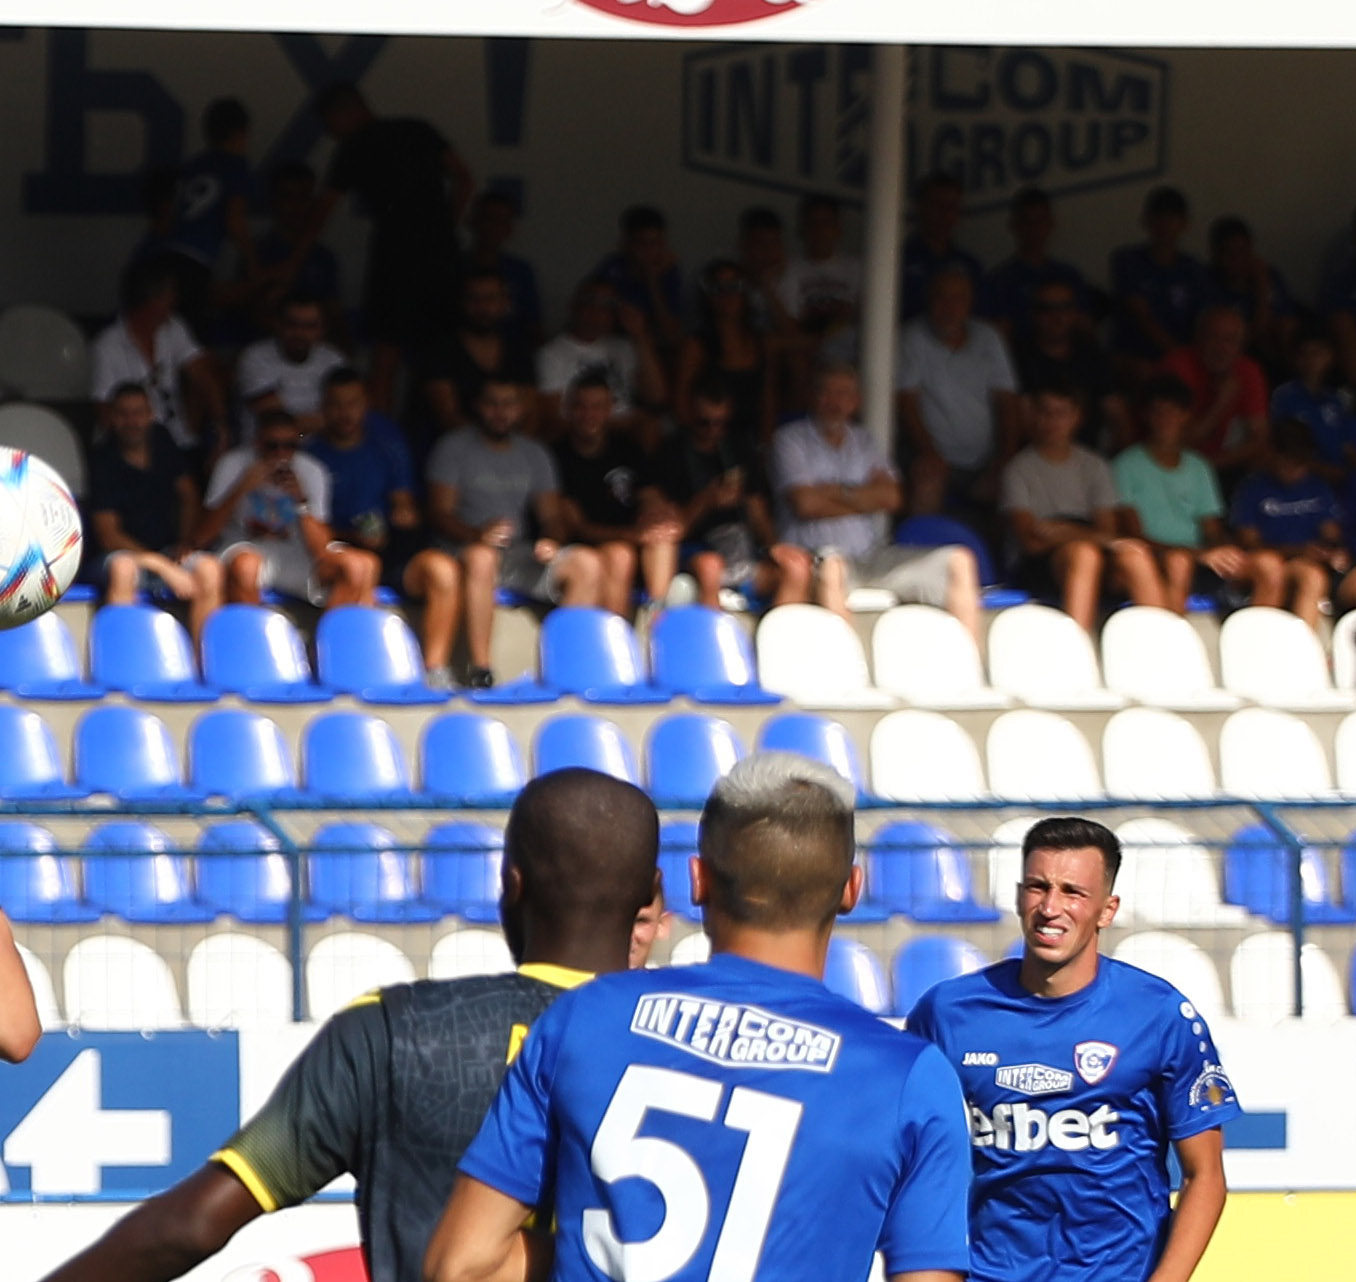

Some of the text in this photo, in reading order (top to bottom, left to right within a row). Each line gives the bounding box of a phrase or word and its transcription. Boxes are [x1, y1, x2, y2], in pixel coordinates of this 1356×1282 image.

[696, 46, 1150, 188] INTECOM
[933, 119, 1150, 192] GROUP
[729, 1035, 830, 1062] GROUP
[962, 1052, 999, 1066] JAKO
